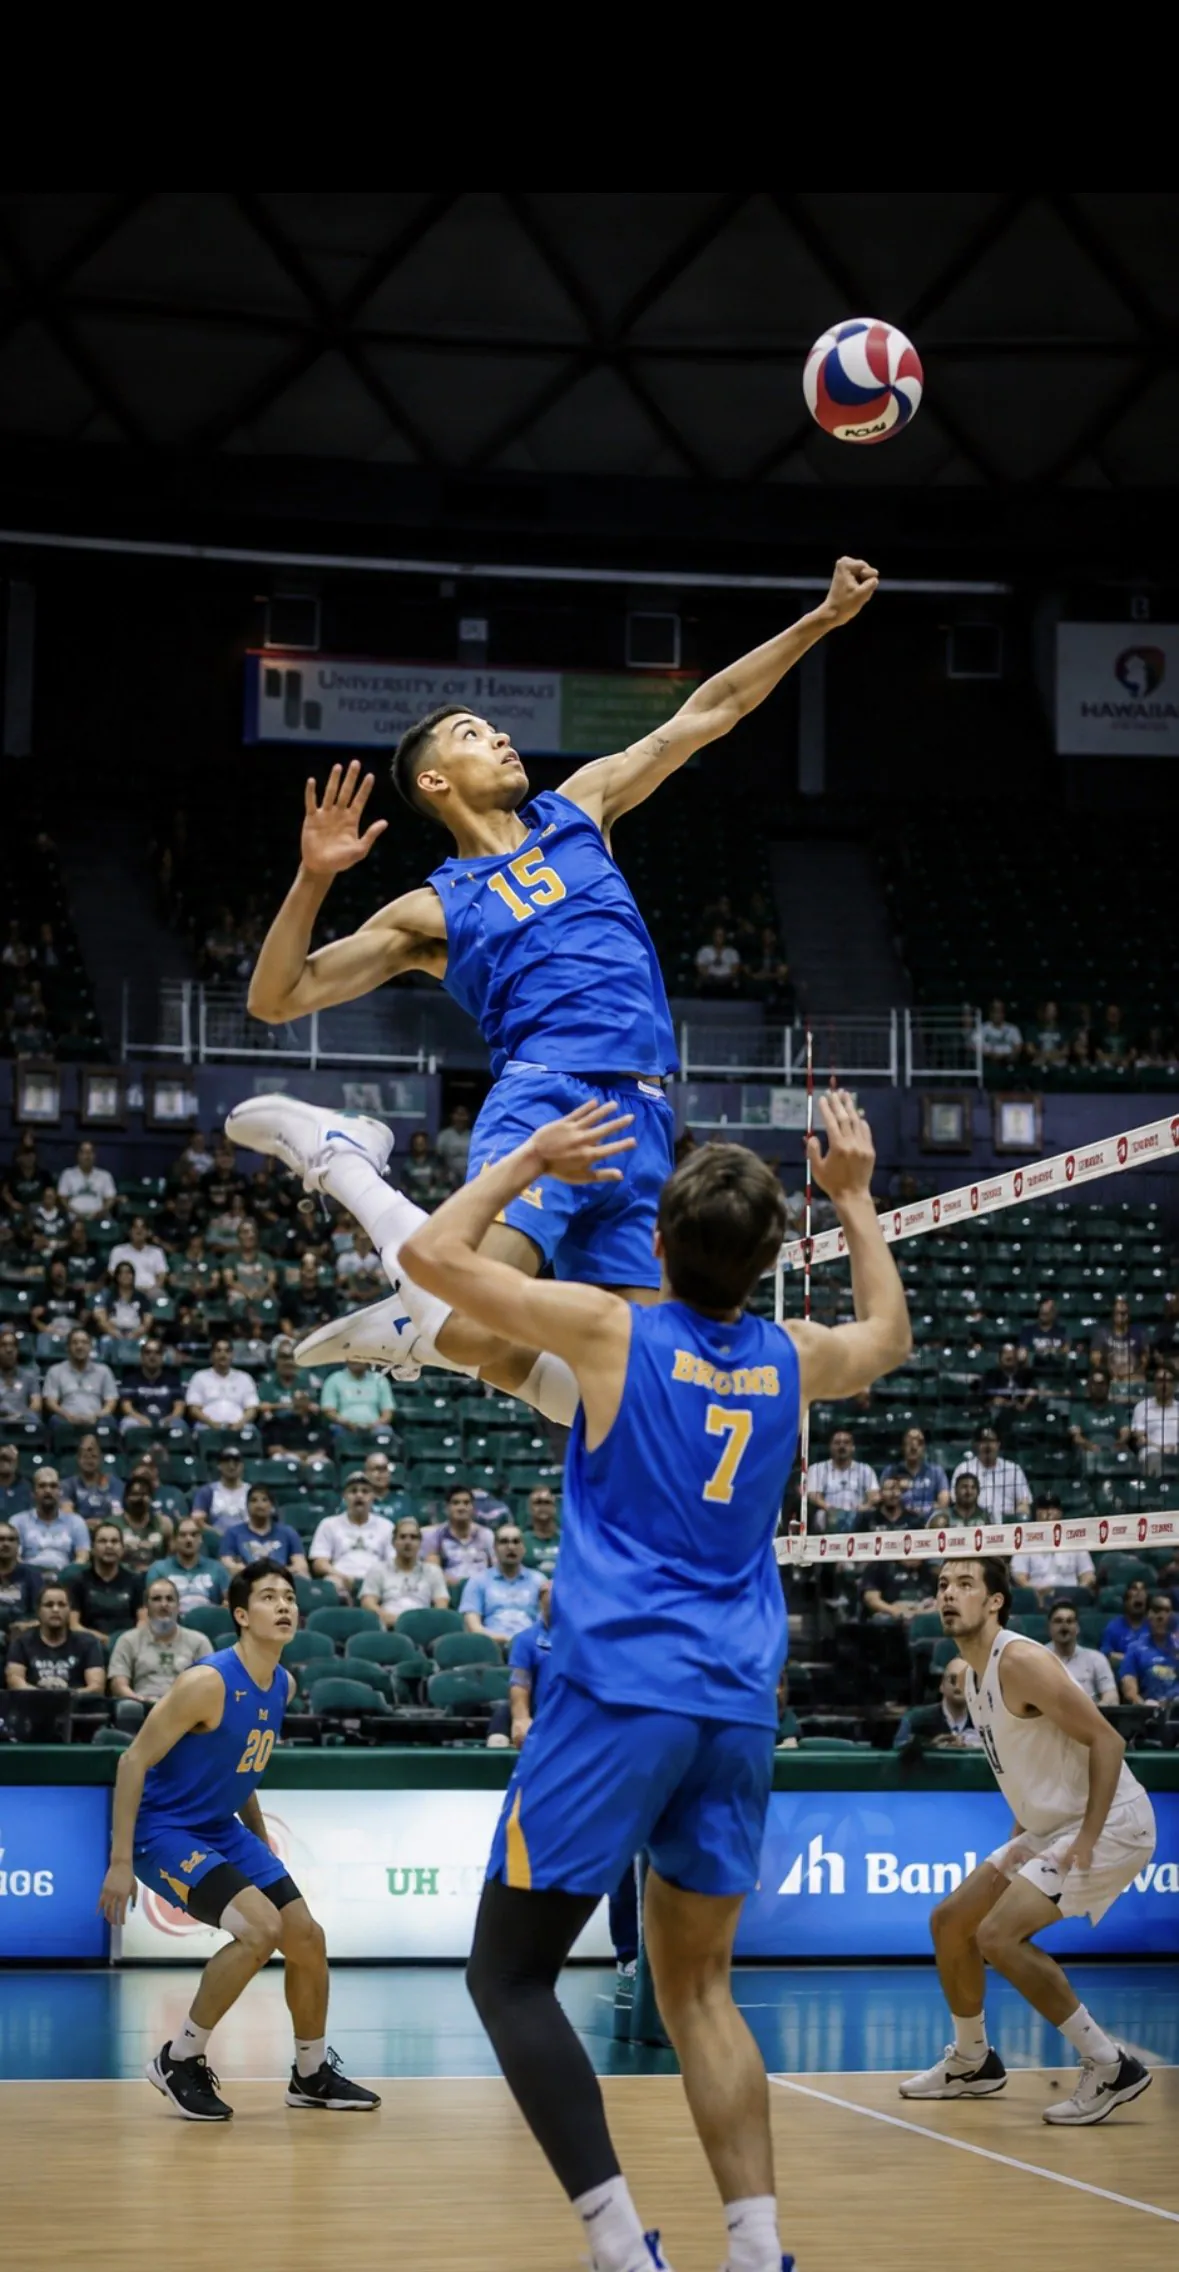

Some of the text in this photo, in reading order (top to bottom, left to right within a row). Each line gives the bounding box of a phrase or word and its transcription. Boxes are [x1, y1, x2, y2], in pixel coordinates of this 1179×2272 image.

[487, 846, 567, 923] 15
[701, 1403, 754, 1505] 7
[235, 1728, 276, 1773] 20
[385, 1867, 440, 1896] UH
